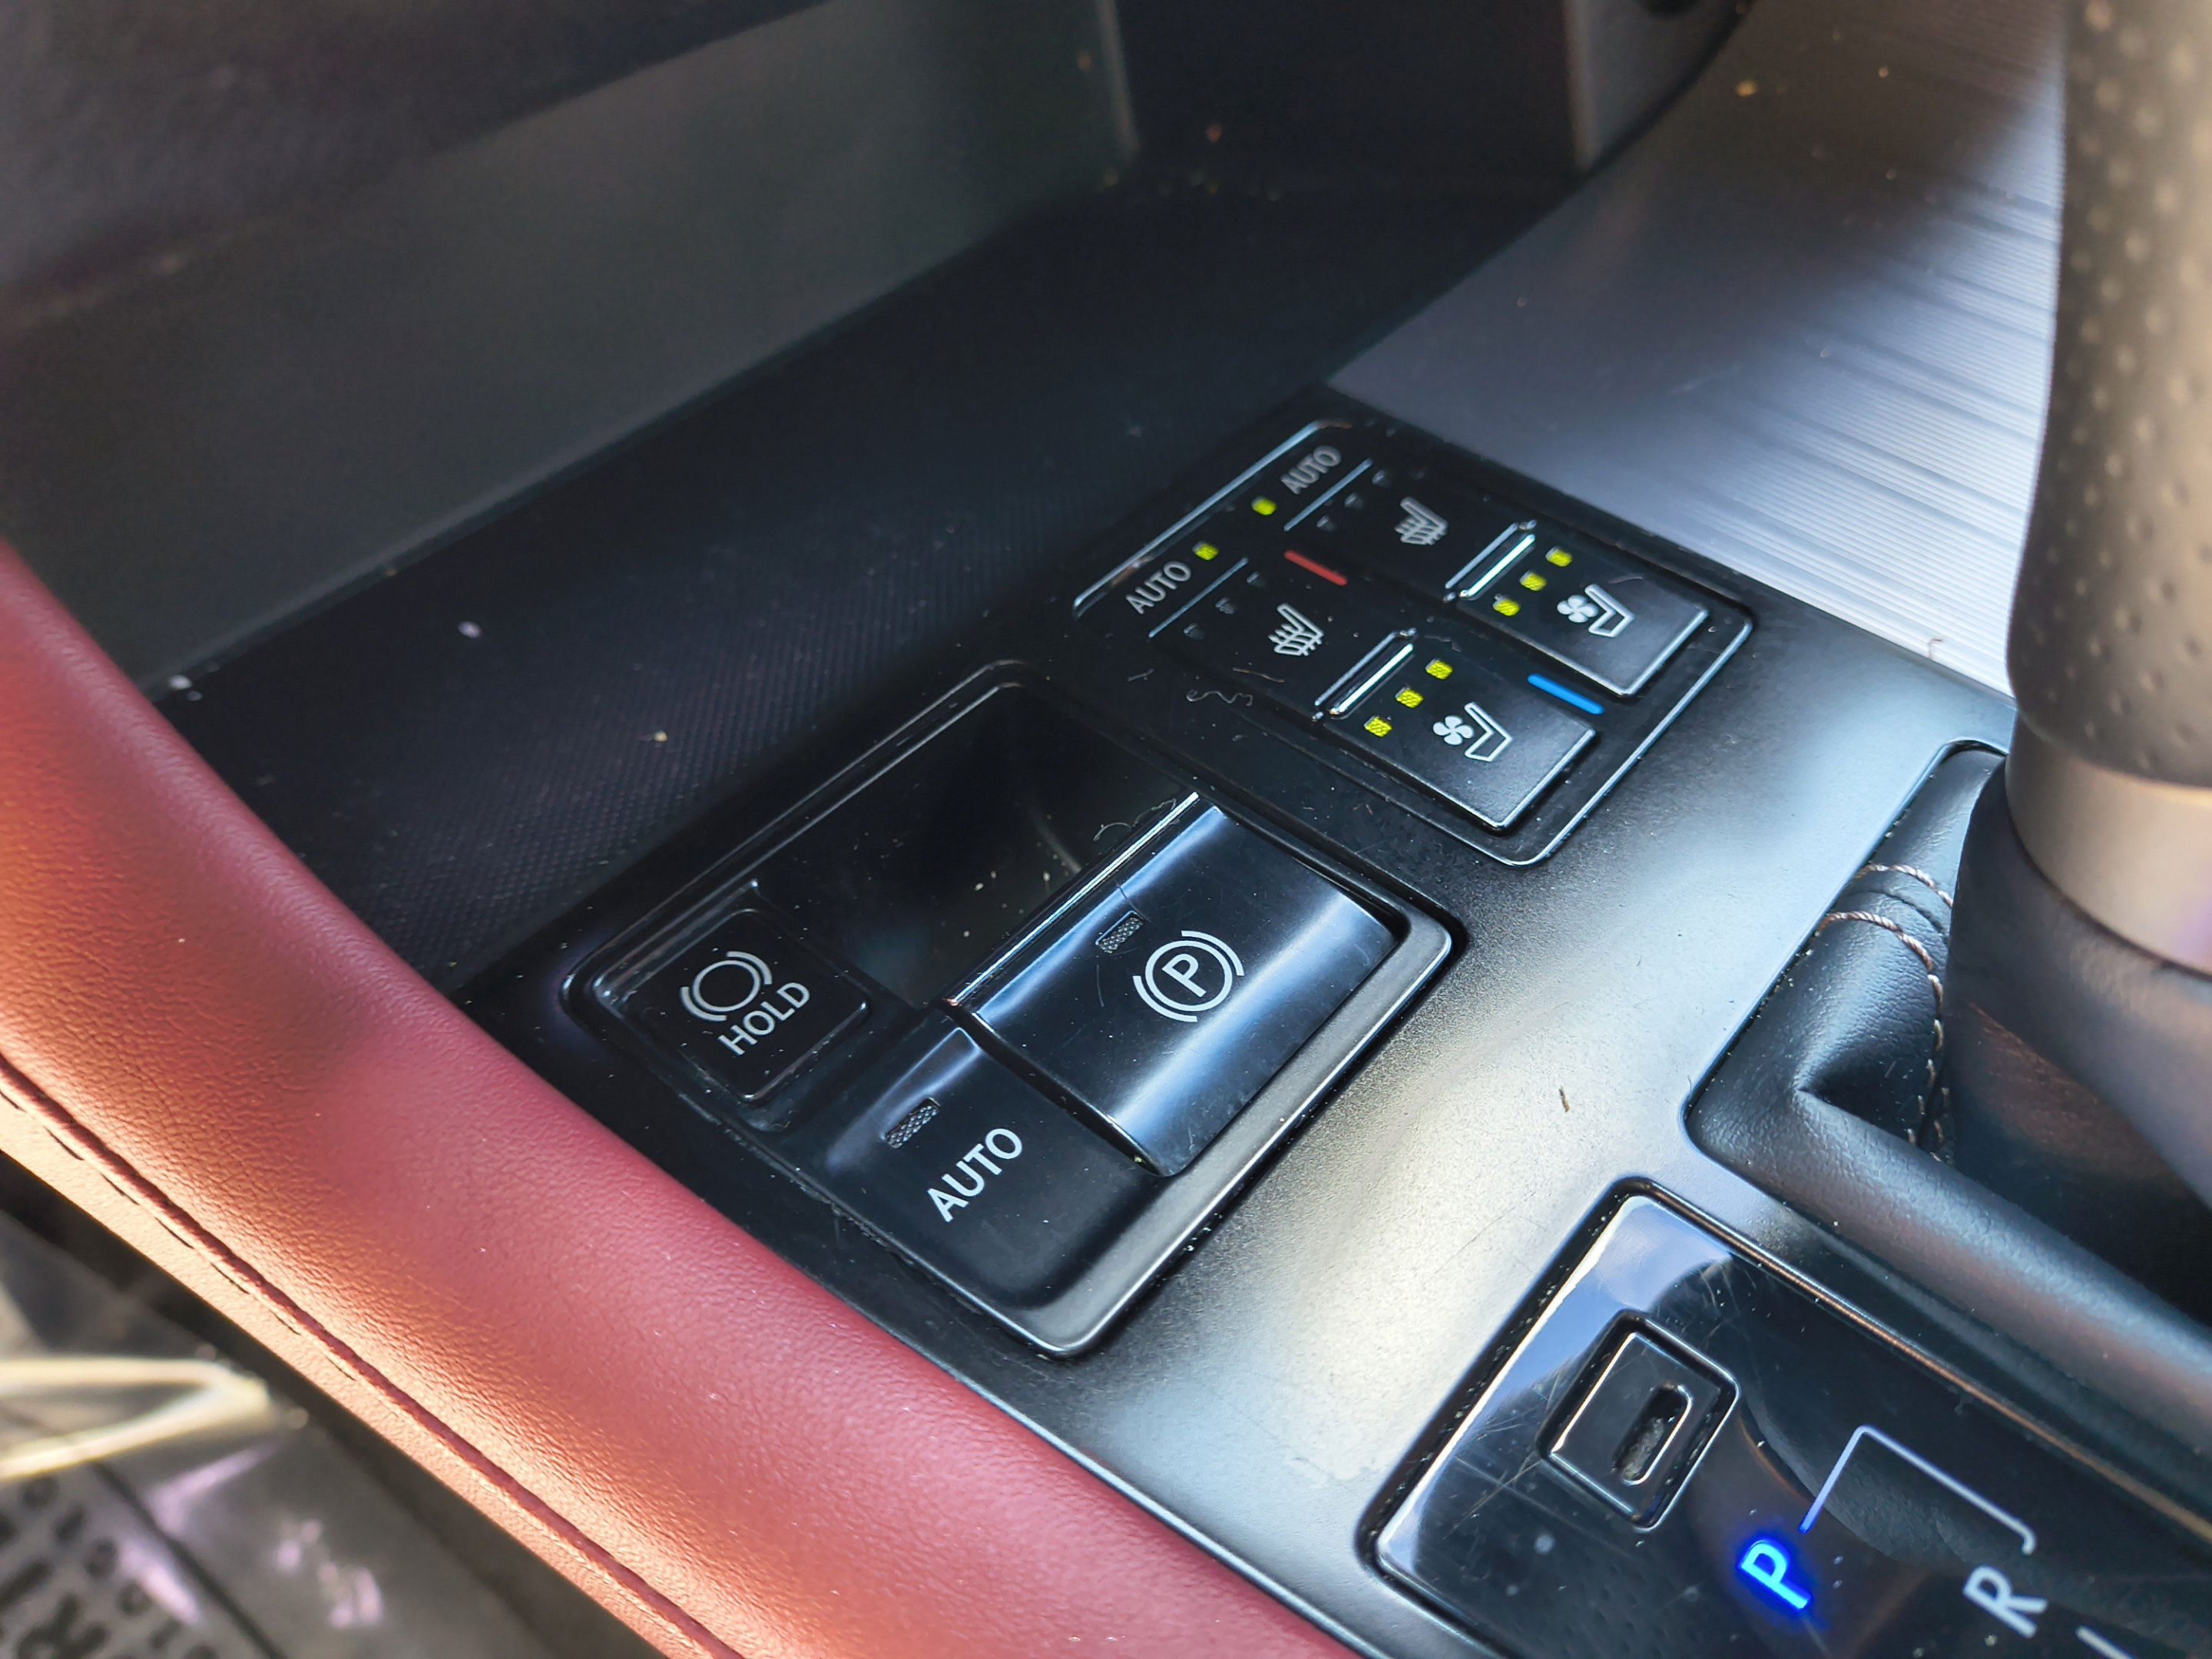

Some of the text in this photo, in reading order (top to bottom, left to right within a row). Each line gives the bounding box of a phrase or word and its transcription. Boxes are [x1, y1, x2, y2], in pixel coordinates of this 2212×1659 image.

[1280, 445, 1342, 494] AUTO
[1125, 561, 1191, 614] AUTO
[1162, 955, 1204, 997] P
[718, 981, 811, 1055] HOLD
[928, 1128, 1022, 1222] AUTO
[1740, 1540, 1811, 1609] P
[1963, 1565, 2048, 1637] R
